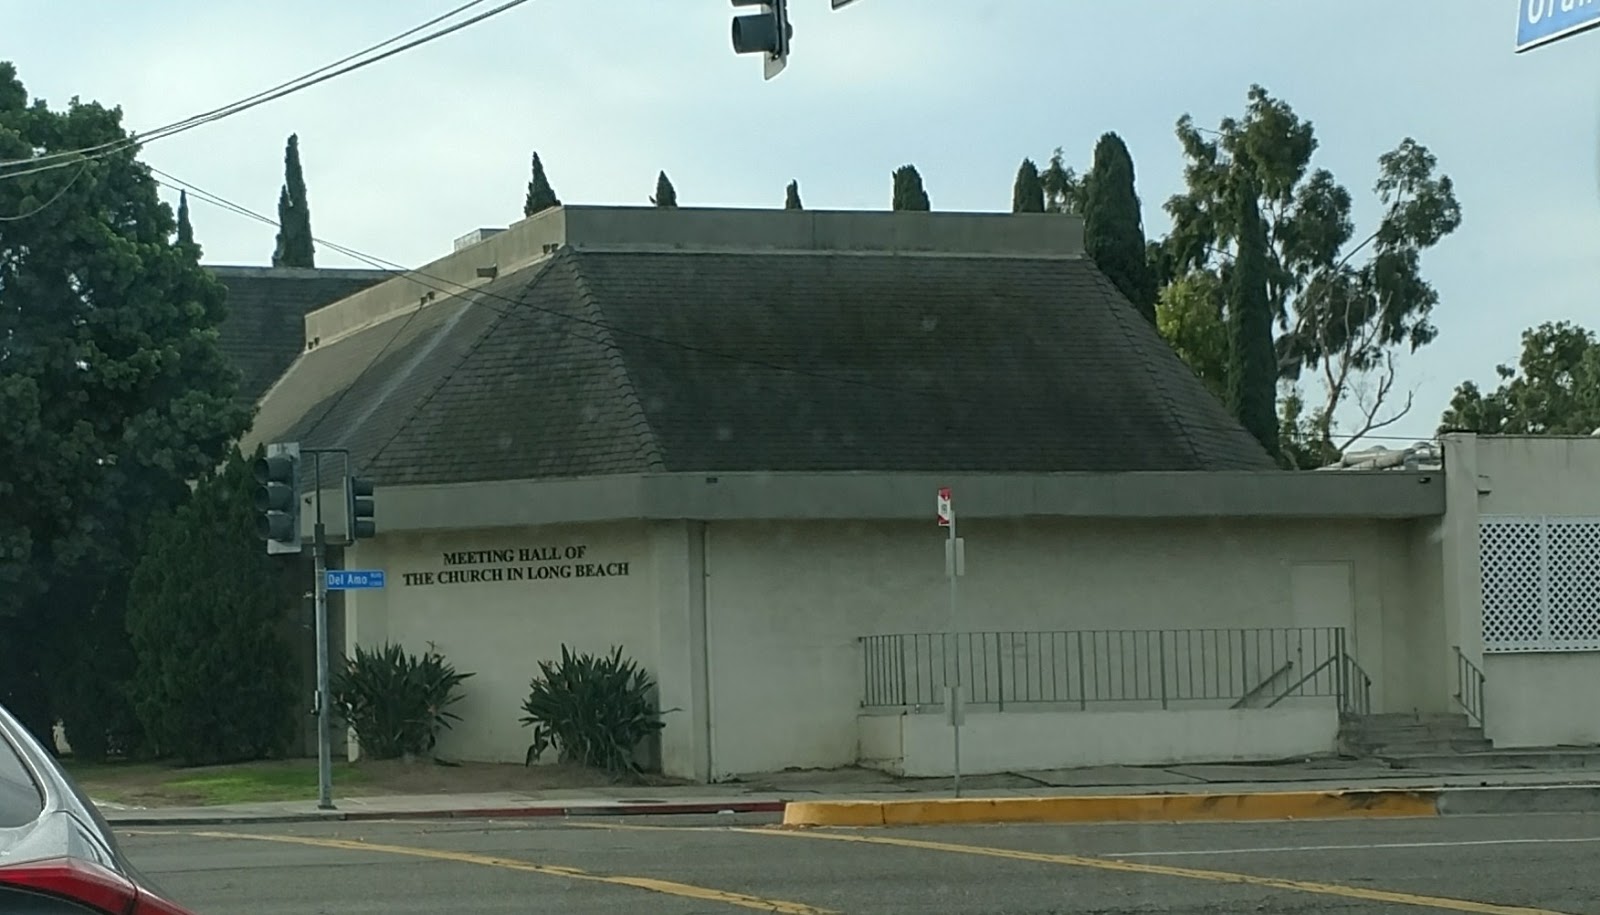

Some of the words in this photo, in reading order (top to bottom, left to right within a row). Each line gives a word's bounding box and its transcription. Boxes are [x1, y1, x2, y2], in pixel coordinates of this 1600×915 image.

[443, 549, 515, 566] MEETING
[519, 547, 562, 561] HALL
[564, 545, 587, 559] OF
[328, 574, 344, 585] Del
[347, 573, 368, 585] Amo
[402, 572, 435, 587] THE
[437, 568, 503, 584] CHURCH
[507, 567, 524, 581] IN
[527, 565, 571, 580] LONG
[575, 562, 629, 578] BEACH
